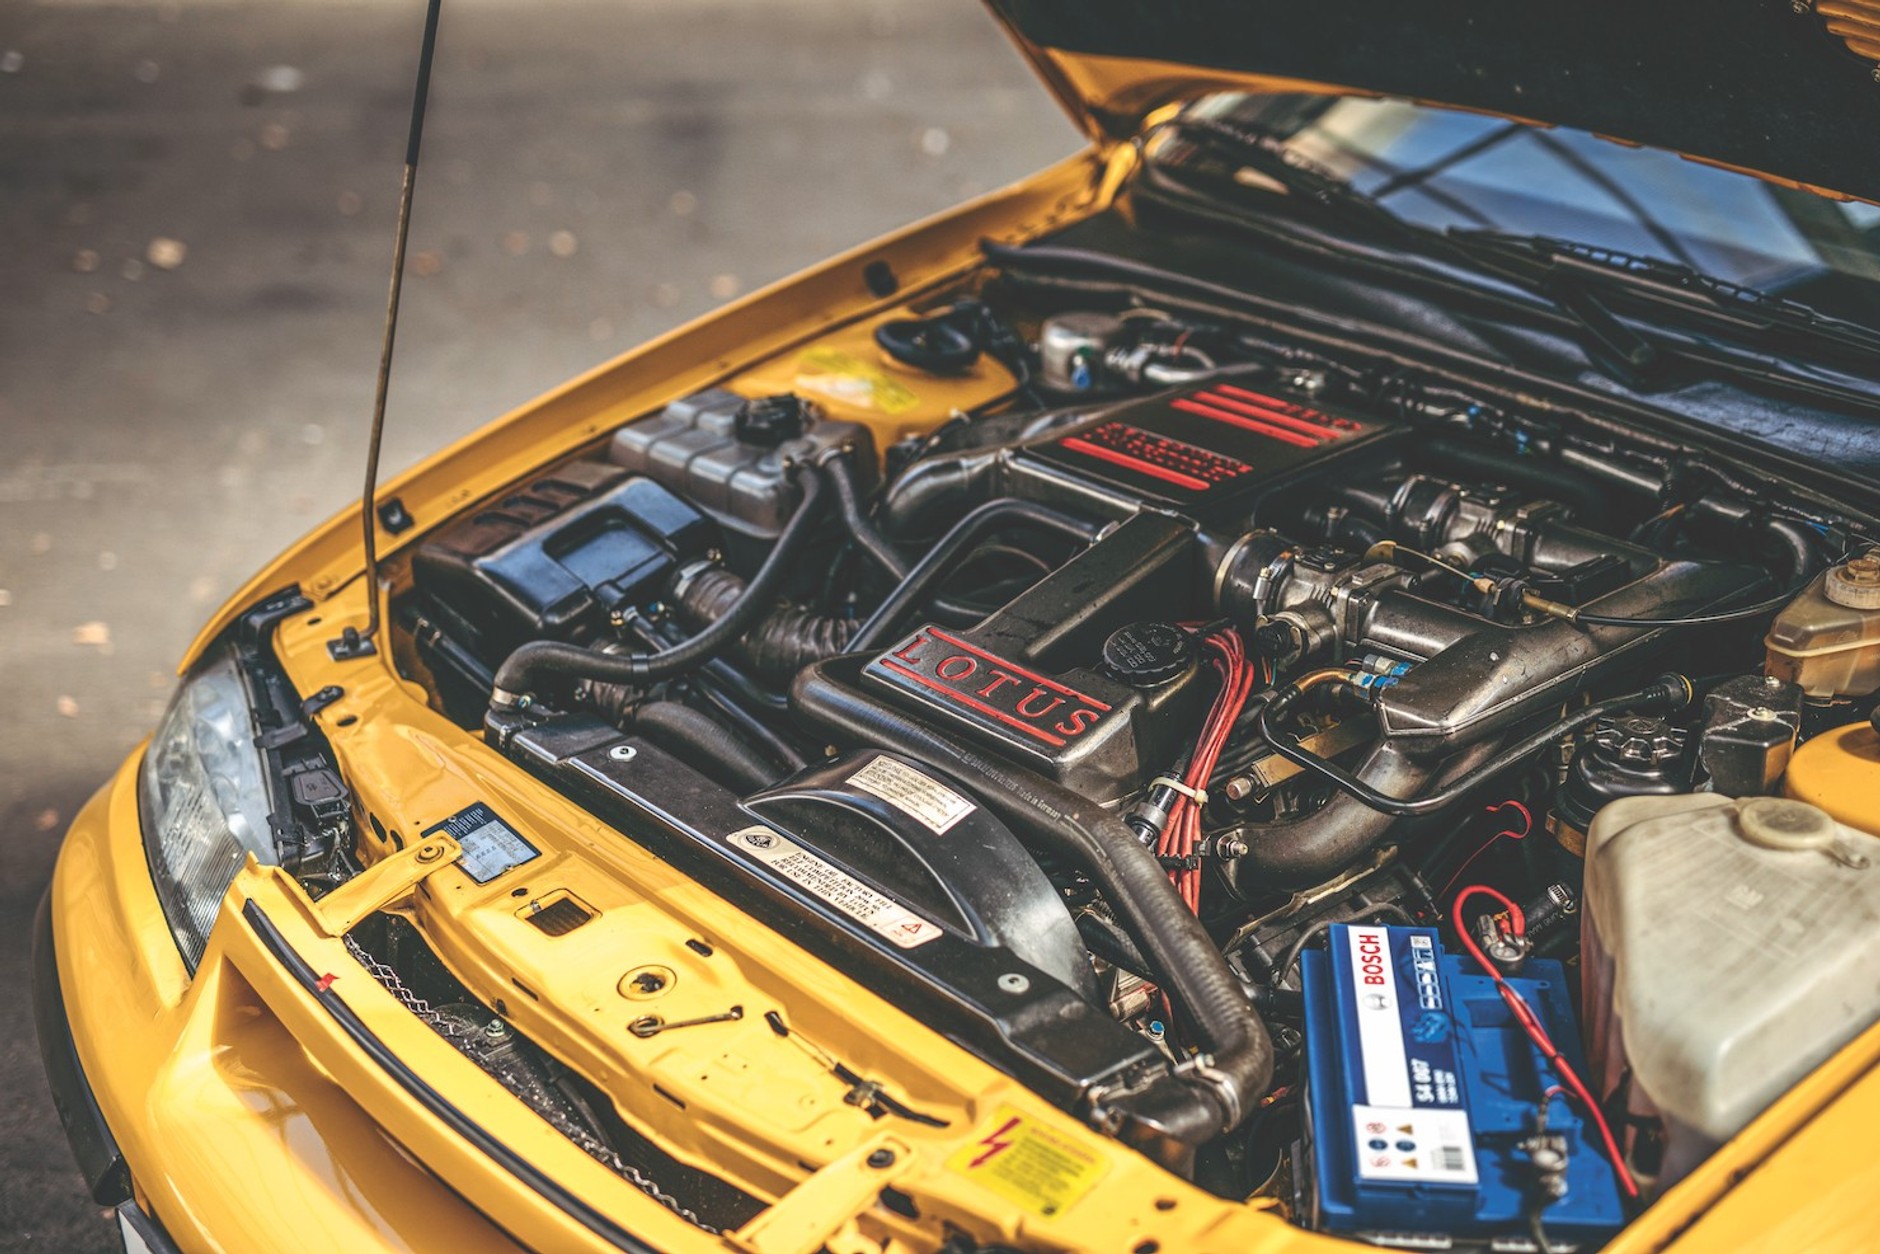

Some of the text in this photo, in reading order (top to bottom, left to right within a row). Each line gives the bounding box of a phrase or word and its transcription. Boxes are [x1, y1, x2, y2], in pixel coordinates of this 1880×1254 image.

[892, 634, 1100, 736] LOTUS
[1037, 799, 1061, 822] Germany
[794, 851, 824, 870] ENGINE
[840, 877, 873, 899] FACTORY
[874, 896, 893, 910] FILL
[813, 884, 832, 898] THIS
[849, 898, 875, 915] LOTUS
[1359, 934, 1385, 985] BOSCH
